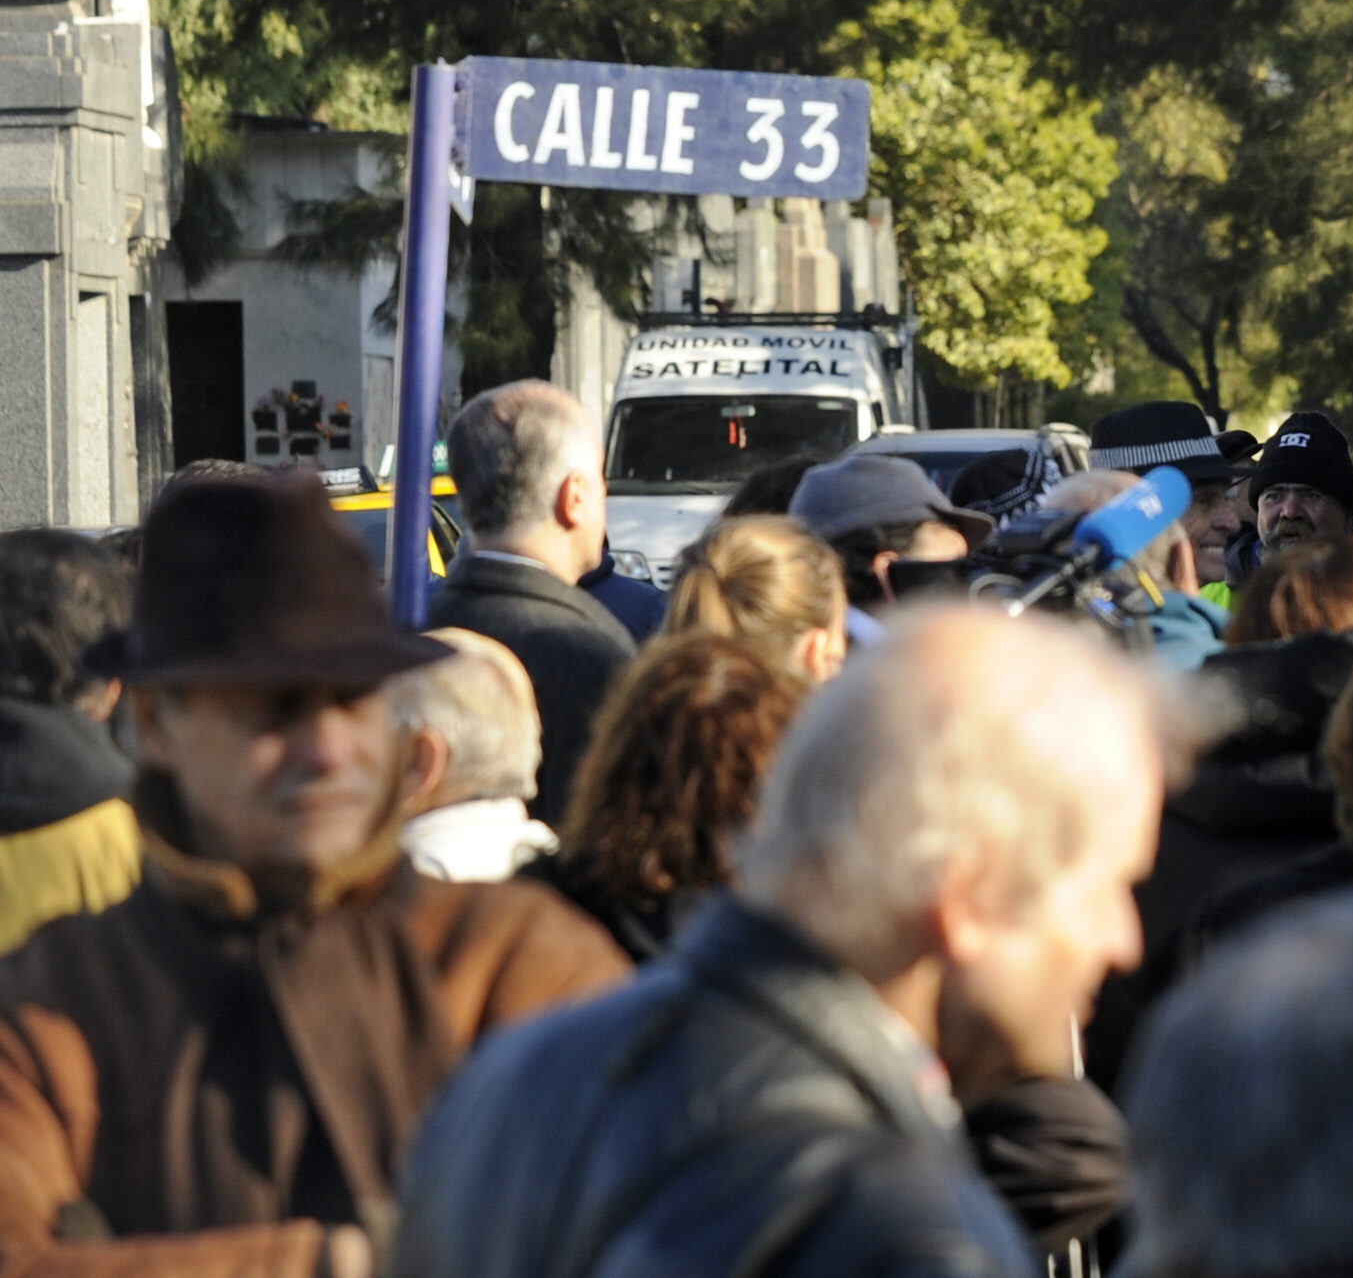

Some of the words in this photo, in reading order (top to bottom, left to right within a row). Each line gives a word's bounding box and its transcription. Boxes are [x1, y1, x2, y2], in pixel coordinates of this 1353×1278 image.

[493, 80, 700, 176] CALLE
[738, 97, 842, 184] 33
[636, 334, 750, 353] UNIDAD
[760, 334, 856, 353] MOVIL
[630, 356, 852, 381] SATELITAL
